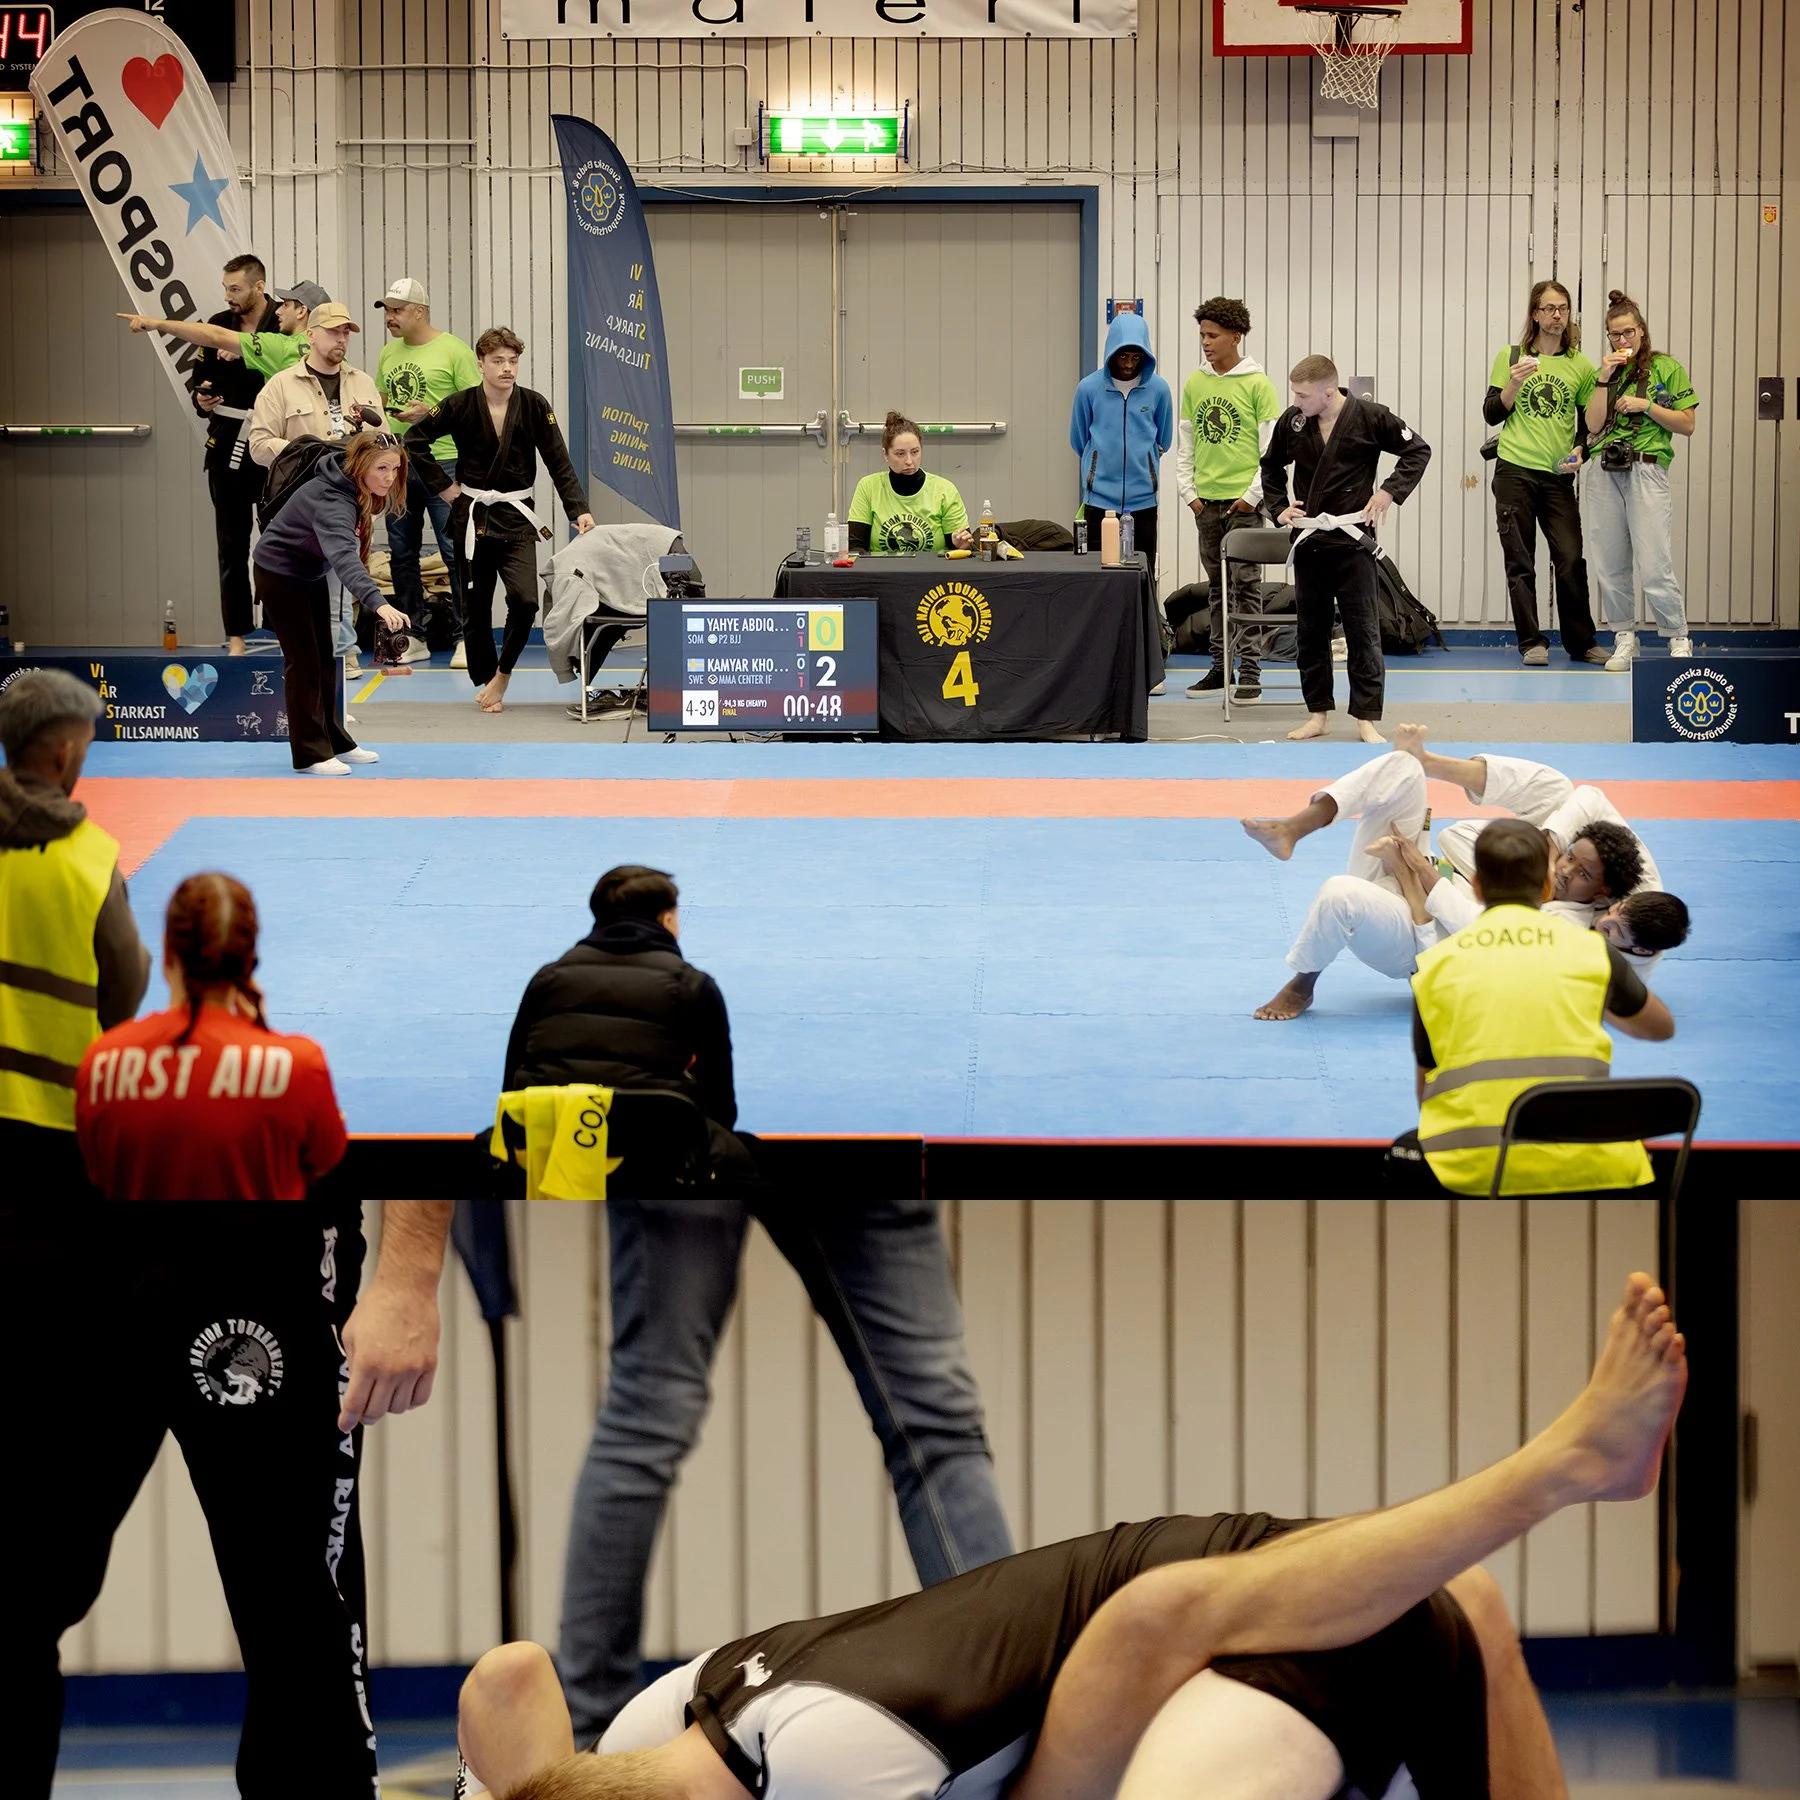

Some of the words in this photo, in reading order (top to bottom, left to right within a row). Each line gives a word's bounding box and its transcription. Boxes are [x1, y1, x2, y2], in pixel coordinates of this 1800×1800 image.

[747, 374, 776, 385] PUSH
[1521, 374, 1543, 398] NATION
[880, 514, 901, 537] NATION
[916, 584, 946, 620] NATION
[947, 582, 992, 641] TOURNAMENT
[706, 617, 739, 632] YAHYE
[796, 617, 806, 630] 0
[815, 615, 837, 646] 0
[917, 623, 934, 643] BJJ
[687, 634, 705, 645] SOM
[718, 634, 728, 645] P2
[729, 634, 742, 645] BJJ
[90, 663, 104, 678] VI
[707, 658, 749, 672] KAMYAR
[796, 658, 806, 670] 0
[815, 655, 837, 687] 2
[98, 680, 117, 698] ÄR
[688, 675, 704, 685] SWE
[718, 675, 736, 685] MMA
[738, 675, 763, 685] CENTER
[941, 650, 980, 707] 4
[1666, 668, 1702, 694] Svenska
[1703, 667, 1728, 687] Budo
[1725, 684, 1734, 694] &
[106, 703, 166, 719] STARKAST
[685, 700, 715, 716] 4-39
[722, 708, 737, 716] FINAL
[114, 724, 200, 739] TILLSAMMANS
[1664, 703, 1738, 740] Kampsportsförbundet
[1457, 926, 1555, 950] COACH
[90, 1046, 201, 1106] FIRST
[208, 1045, 294, 1099] AID
[189, 1322, 224, 1368] NATION
[226, 1318, 284, 1389] TOURNAMENT
[193, 1372, 210, 1395] BJJ
